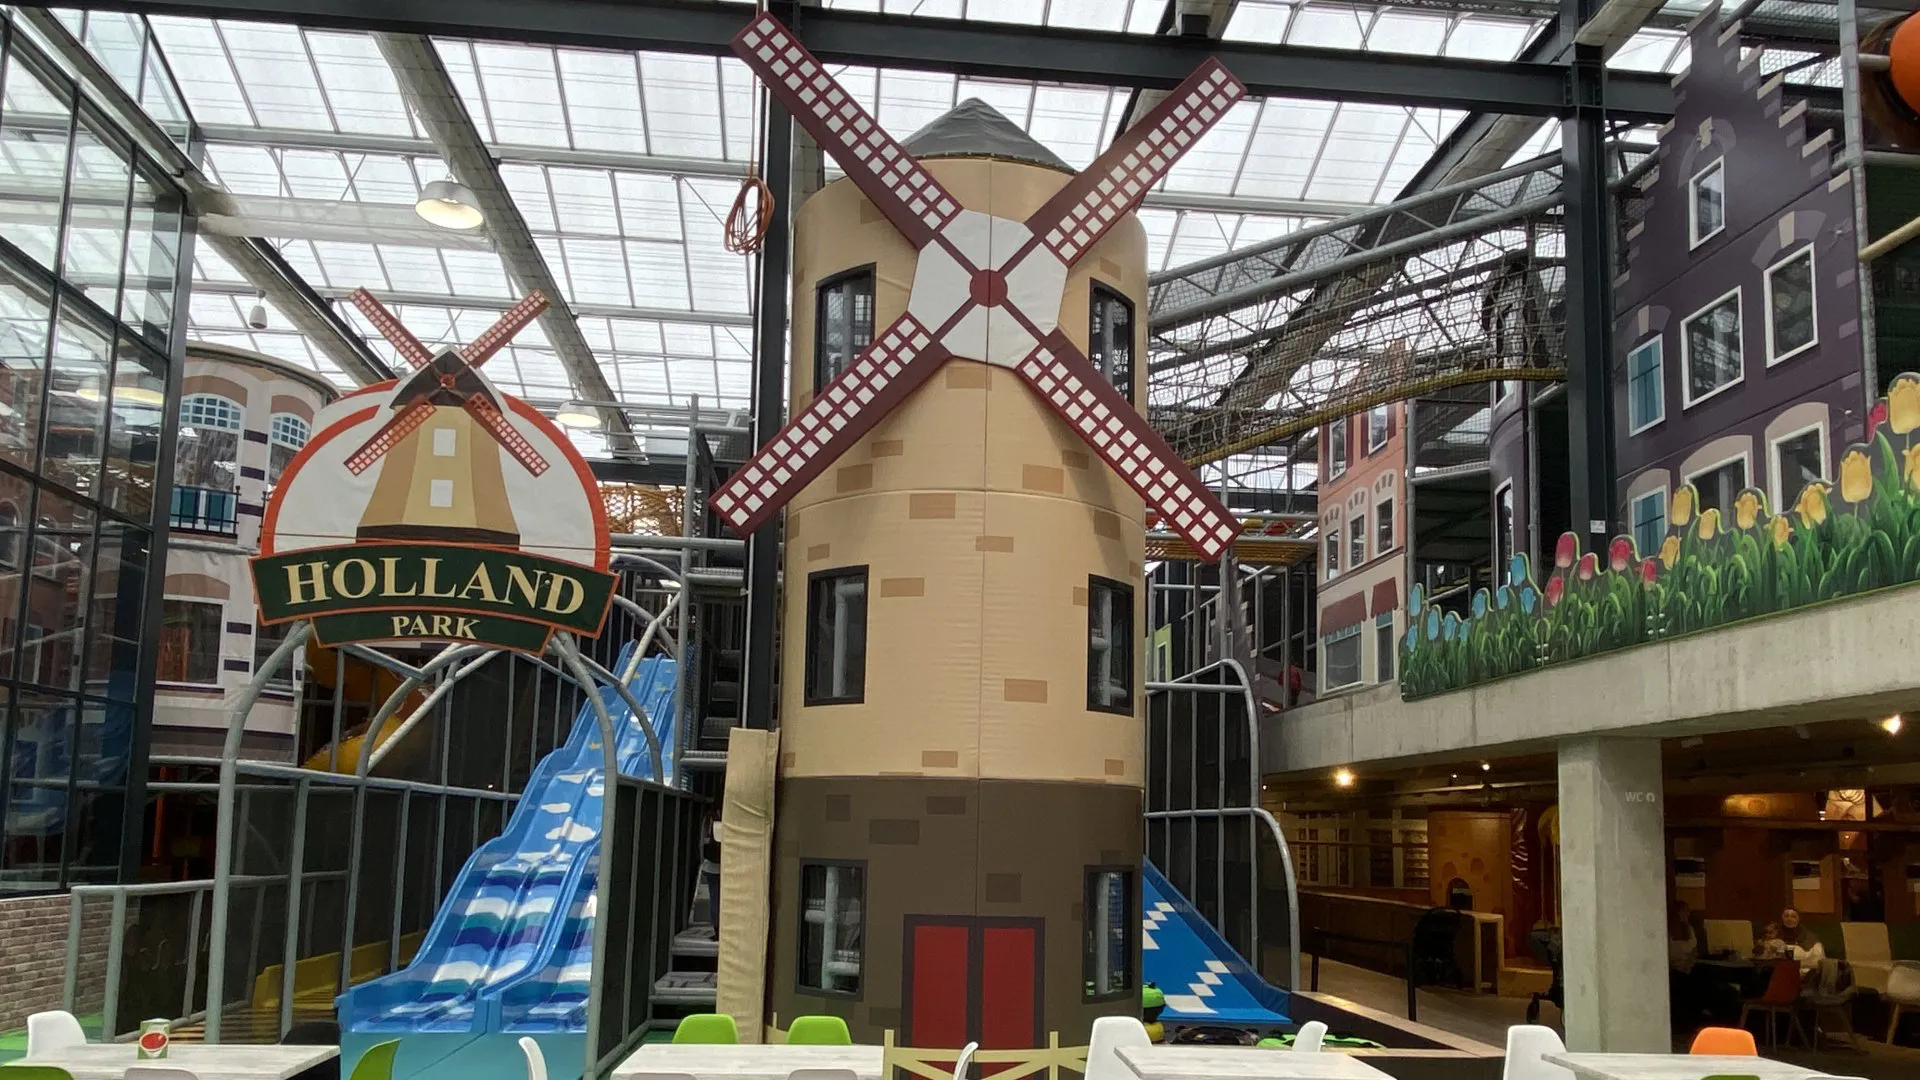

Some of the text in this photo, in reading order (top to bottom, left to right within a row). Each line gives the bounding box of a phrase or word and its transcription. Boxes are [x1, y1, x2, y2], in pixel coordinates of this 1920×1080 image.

[283, 557, 585, 614] HOLLAND
[391, 615, 480, 640] PARK
[1625, 791, 1643, 802] WC
